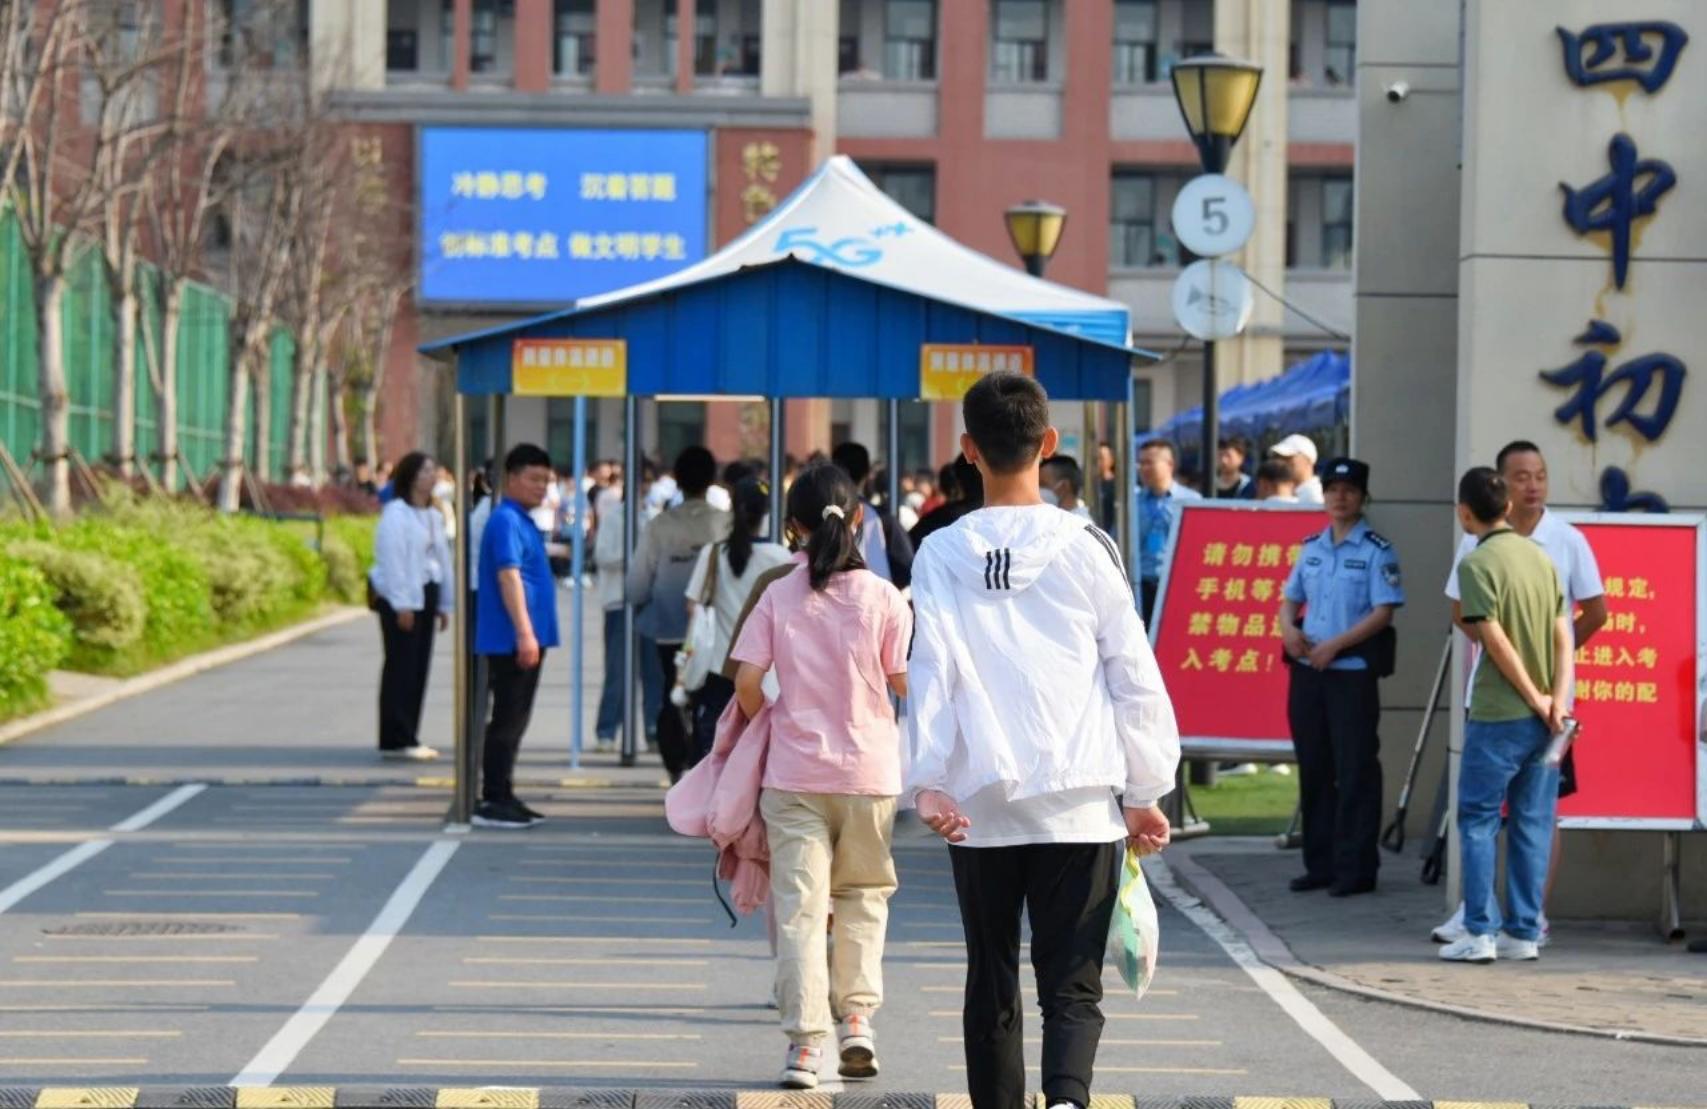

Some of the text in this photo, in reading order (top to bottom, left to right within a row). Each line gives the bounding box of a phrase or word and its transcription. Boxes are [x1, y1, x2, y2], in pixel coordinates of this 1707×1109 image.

[1202, 197, 1229, 236] 5
[1195, 577, 1287, 602] 手机等
